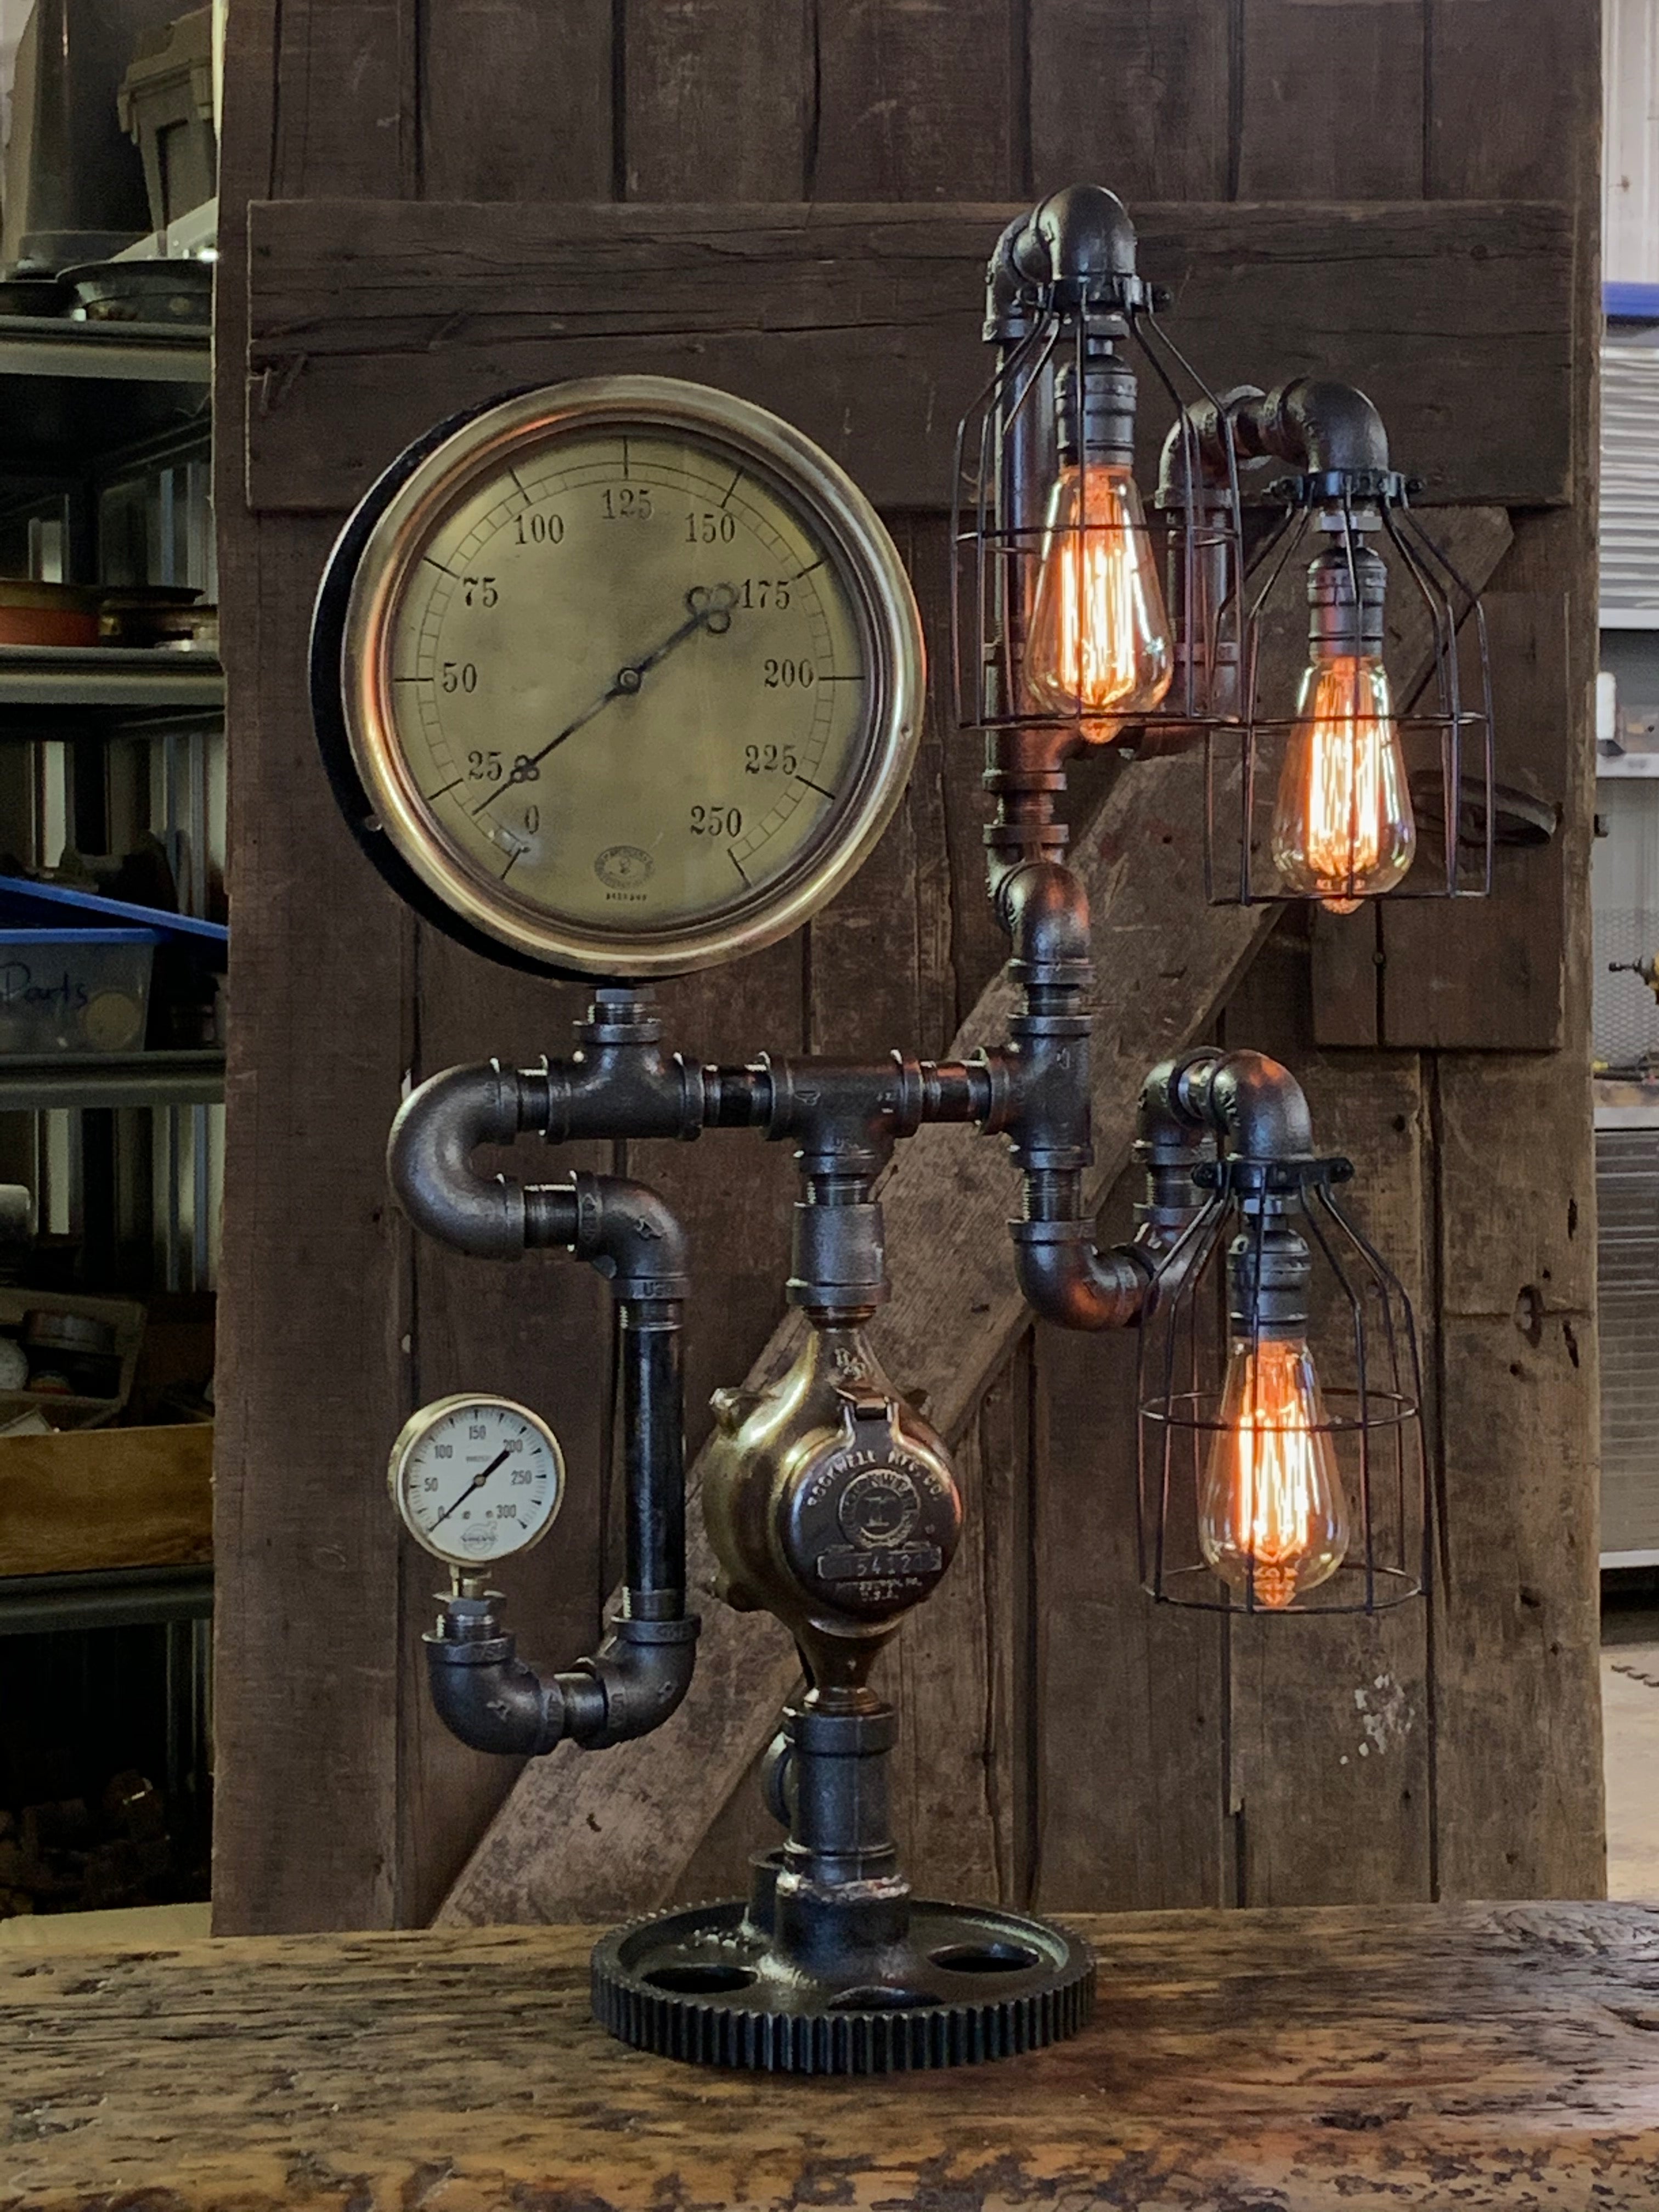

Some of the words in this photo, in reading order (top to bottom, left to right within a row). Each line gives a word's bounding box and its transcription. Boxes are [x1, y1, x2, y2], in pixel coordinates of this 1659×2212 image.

[601, 488, 653, 520] 125
[514, 514, 565, 545] 100
[684, 512, 736, 543] 150
[462, 577, 499, 608] 75
[741, 578, 791, 610] 175
[442, 662, 477, 693] 50
[764, 658, 814, 688] 200
[467, 751, 503, 781] 25
[744, 743, 797, 776] 225
[523, 804, 540, 834] 0
[690, 805, 742, 838] 250
[469, 1425, 487, 1440] 150
[503, 1438, 523, 1453] 200
[435, 1444, 453, 1459] 100
[424, 1477, 438, 1492] 50
[510, 1470, 533, 1485] 250
[496, 1504, 516, 1519] 300
